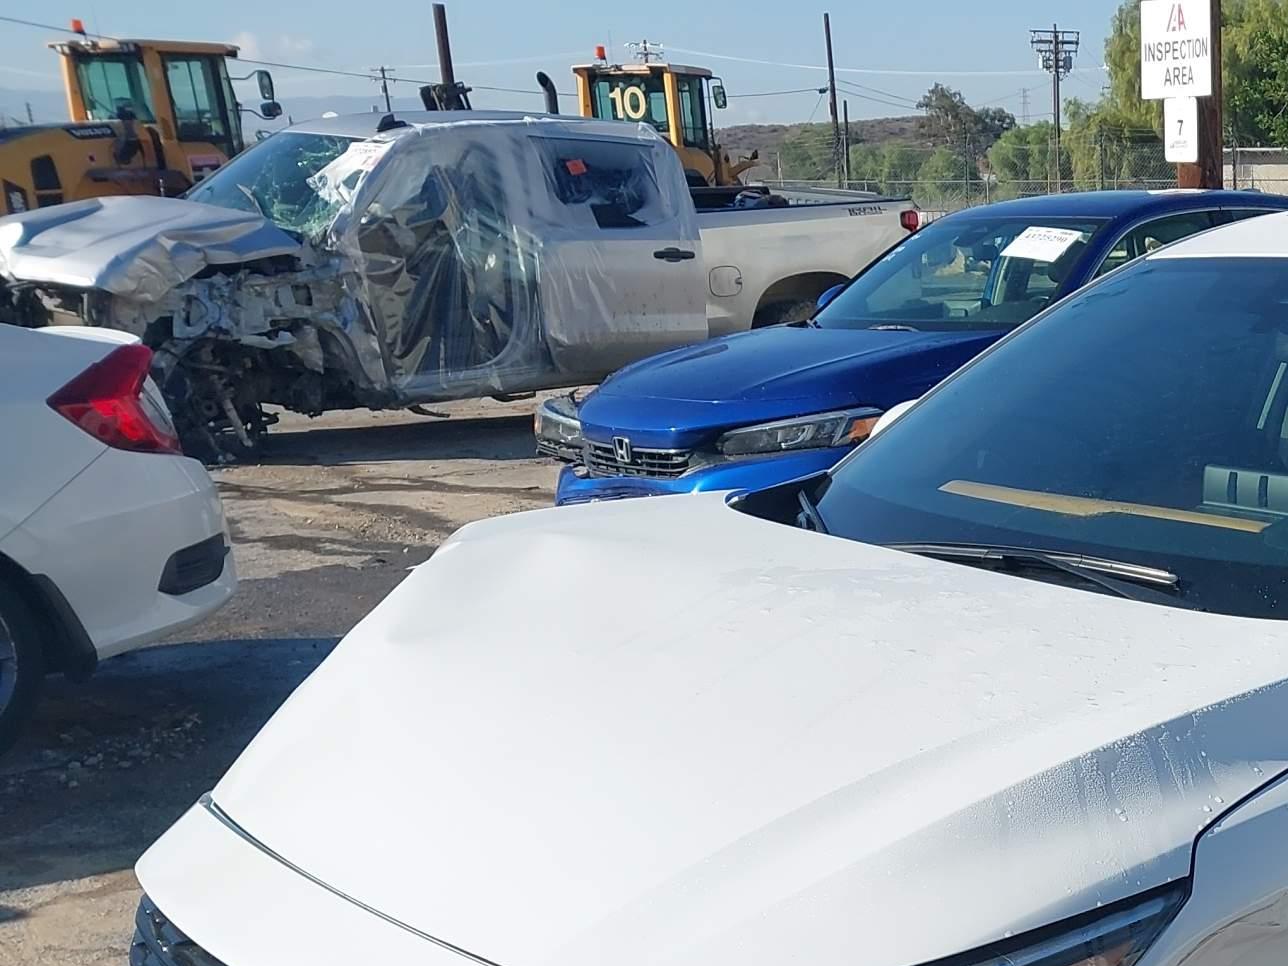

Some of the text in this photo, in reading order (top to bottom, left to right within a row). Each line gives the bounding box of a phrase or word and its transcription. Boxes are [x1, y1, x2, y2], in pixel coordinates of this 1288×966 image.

[1144, 37, 1208, 62] INSPECTION
[1164, 65, 1194, 87] AREA
[609, 85, 647, 119] 10
[1176, 119, 1184, 136] 7
